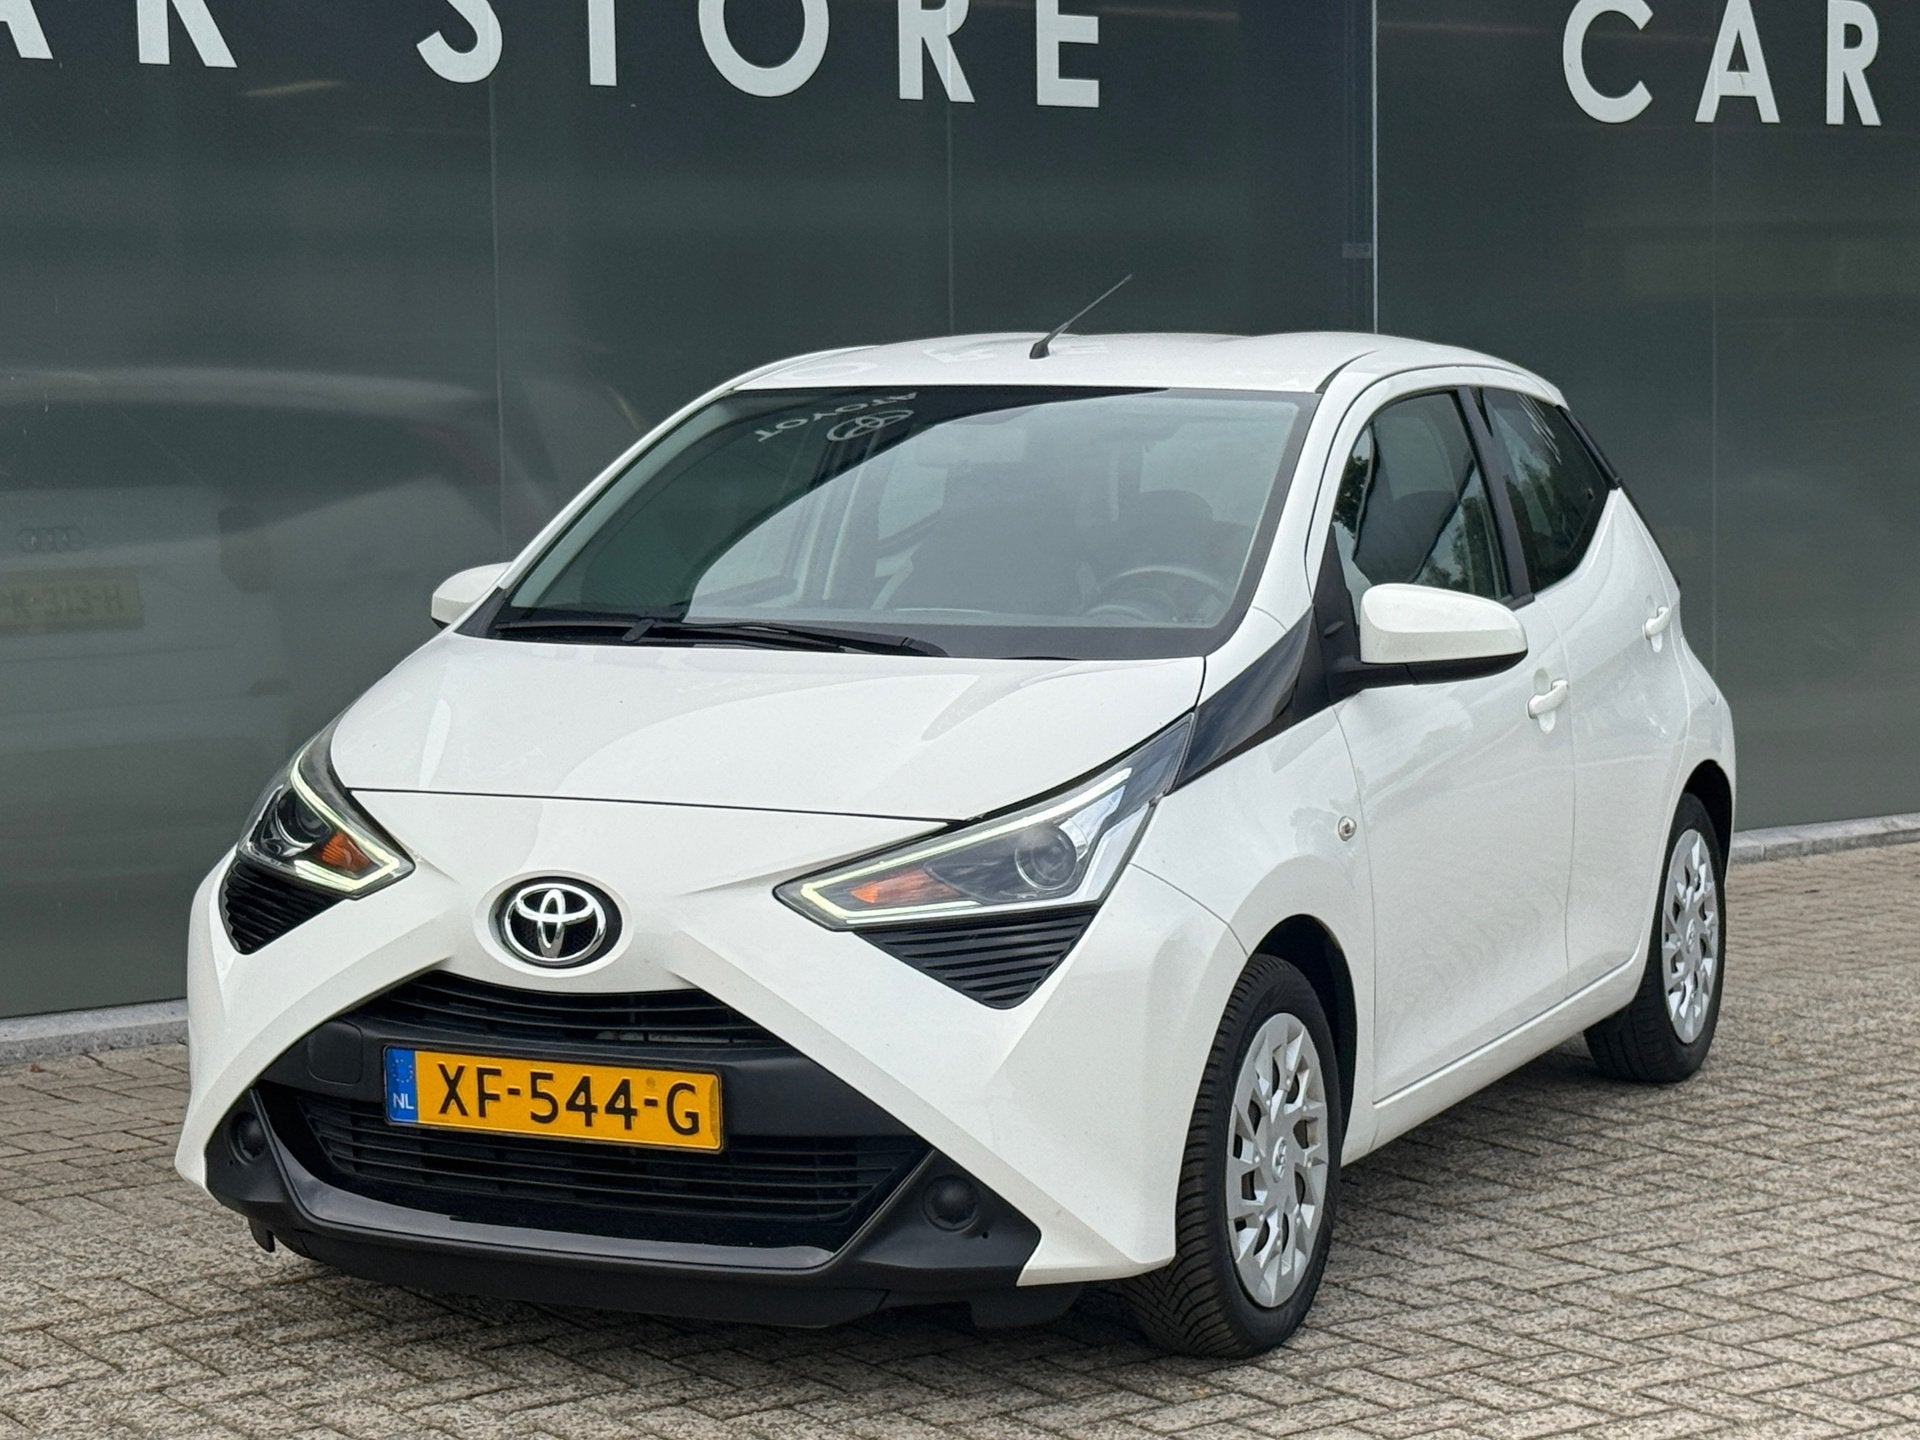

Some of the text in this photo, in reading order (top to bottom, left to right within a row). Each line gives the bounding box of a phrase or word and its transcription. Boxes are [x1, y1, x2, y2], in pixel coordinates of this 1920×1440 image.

[1563, 0, 1880, 125] CAR
[393, 1092, 415, 1110] NL
[438, 1063, 700, 1136] XF-544-G
